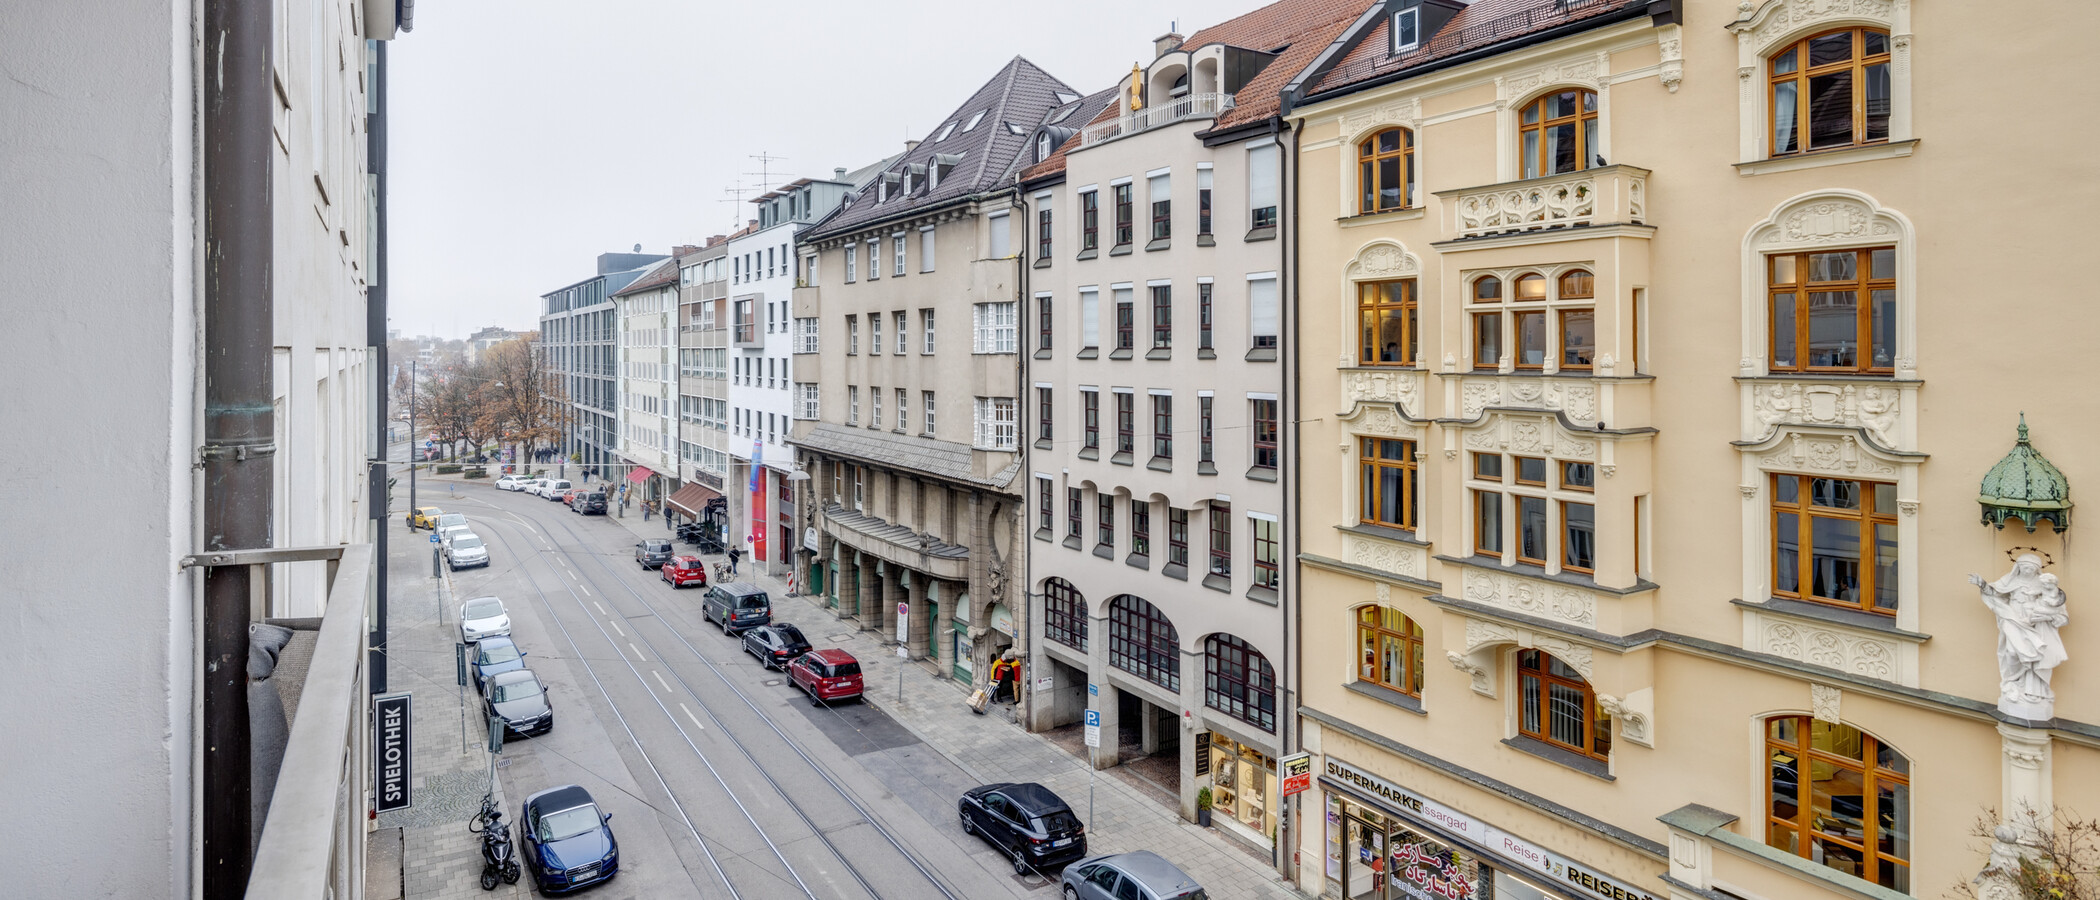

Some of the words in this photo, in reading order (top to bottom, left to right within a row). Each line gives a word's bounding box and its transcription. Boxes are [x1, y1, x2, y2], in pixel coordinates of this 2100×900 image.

[1087, 712, 1096, 724] P
[385, 706, 401, 802] SPIELOTHEK
[1327, 761, 1424, 814] SUPERMARKE
[1423, 805, 1468, 832] ssargad
[1503, 837, 1539, 863] Reise
